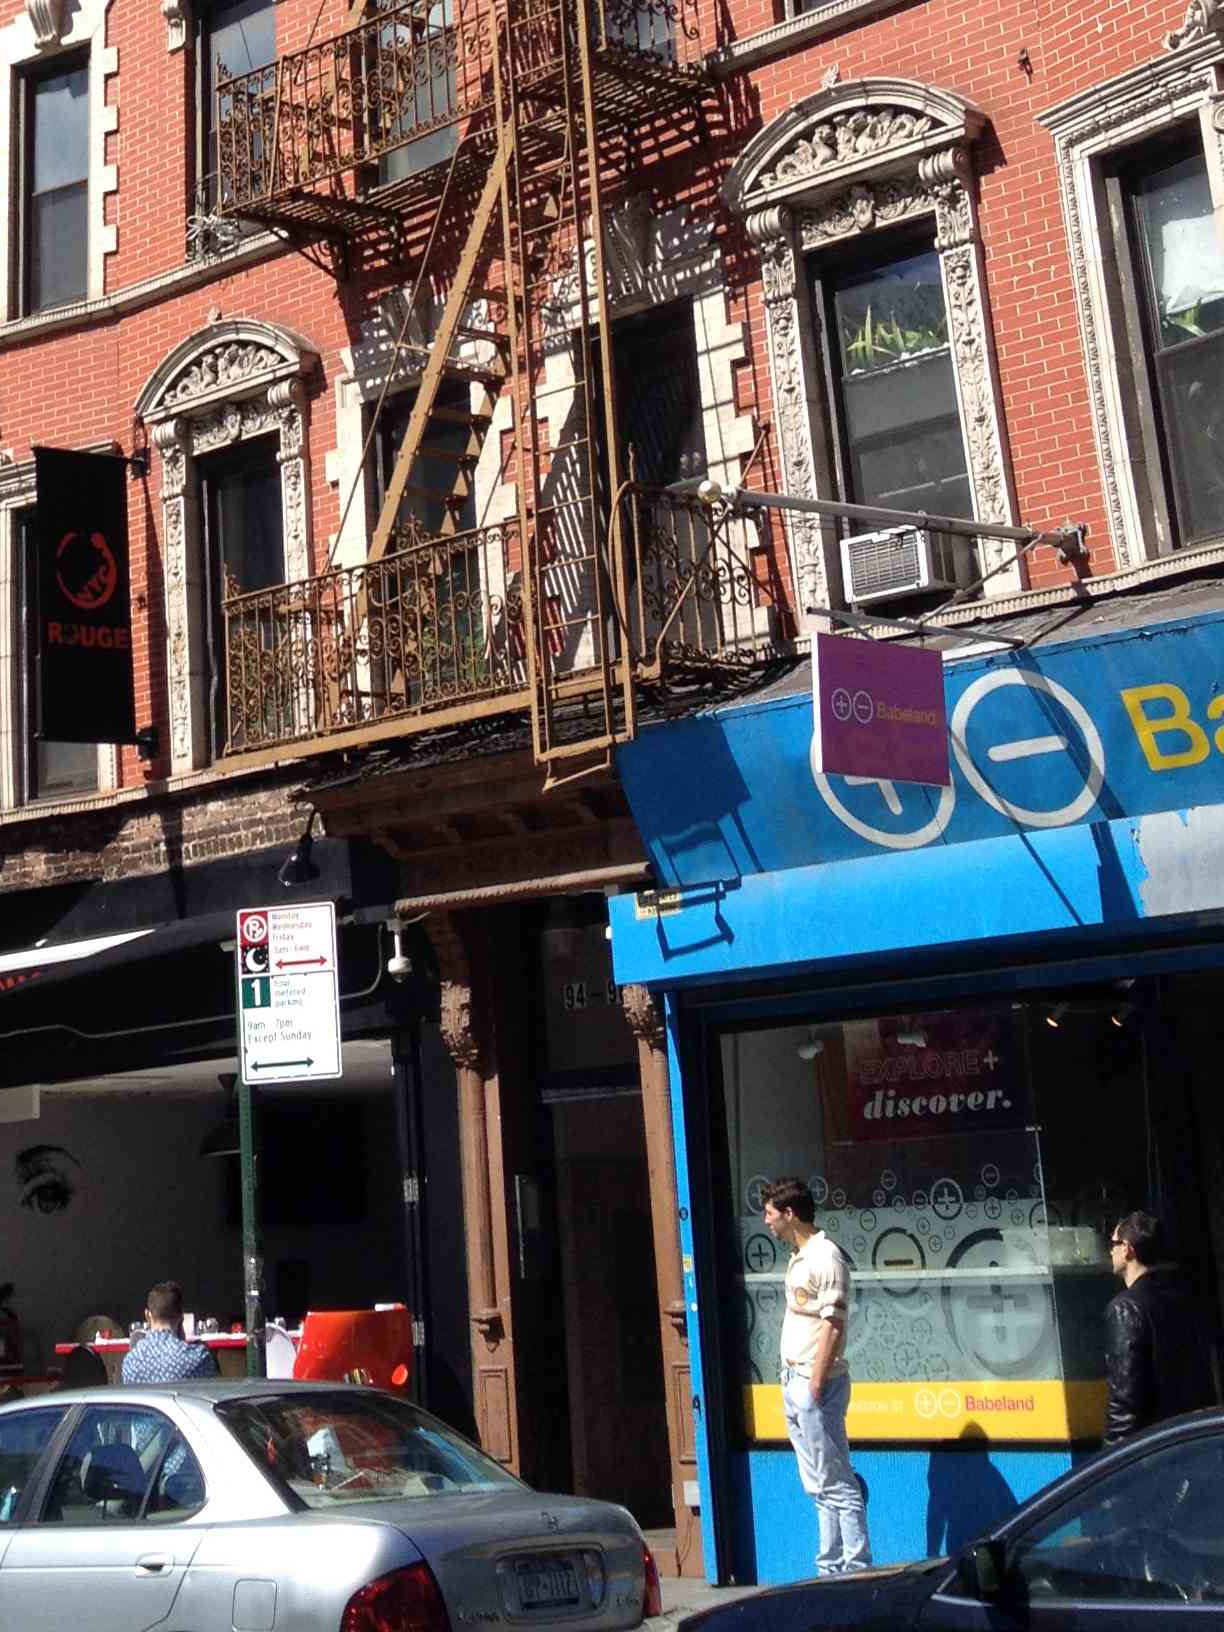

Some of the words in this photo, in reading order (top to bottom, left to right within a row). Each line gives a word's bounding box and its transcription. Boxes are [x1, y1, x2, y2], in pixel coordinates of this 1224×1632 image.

[47, 621, 128, 649] ROUGE
[876, 703, 937, 725] Babeland
[251, 978, 262, 1008] 1
[863, 1088, 1012, 1120] discover.
[964, 1395, 1035, 1412] Babeland
